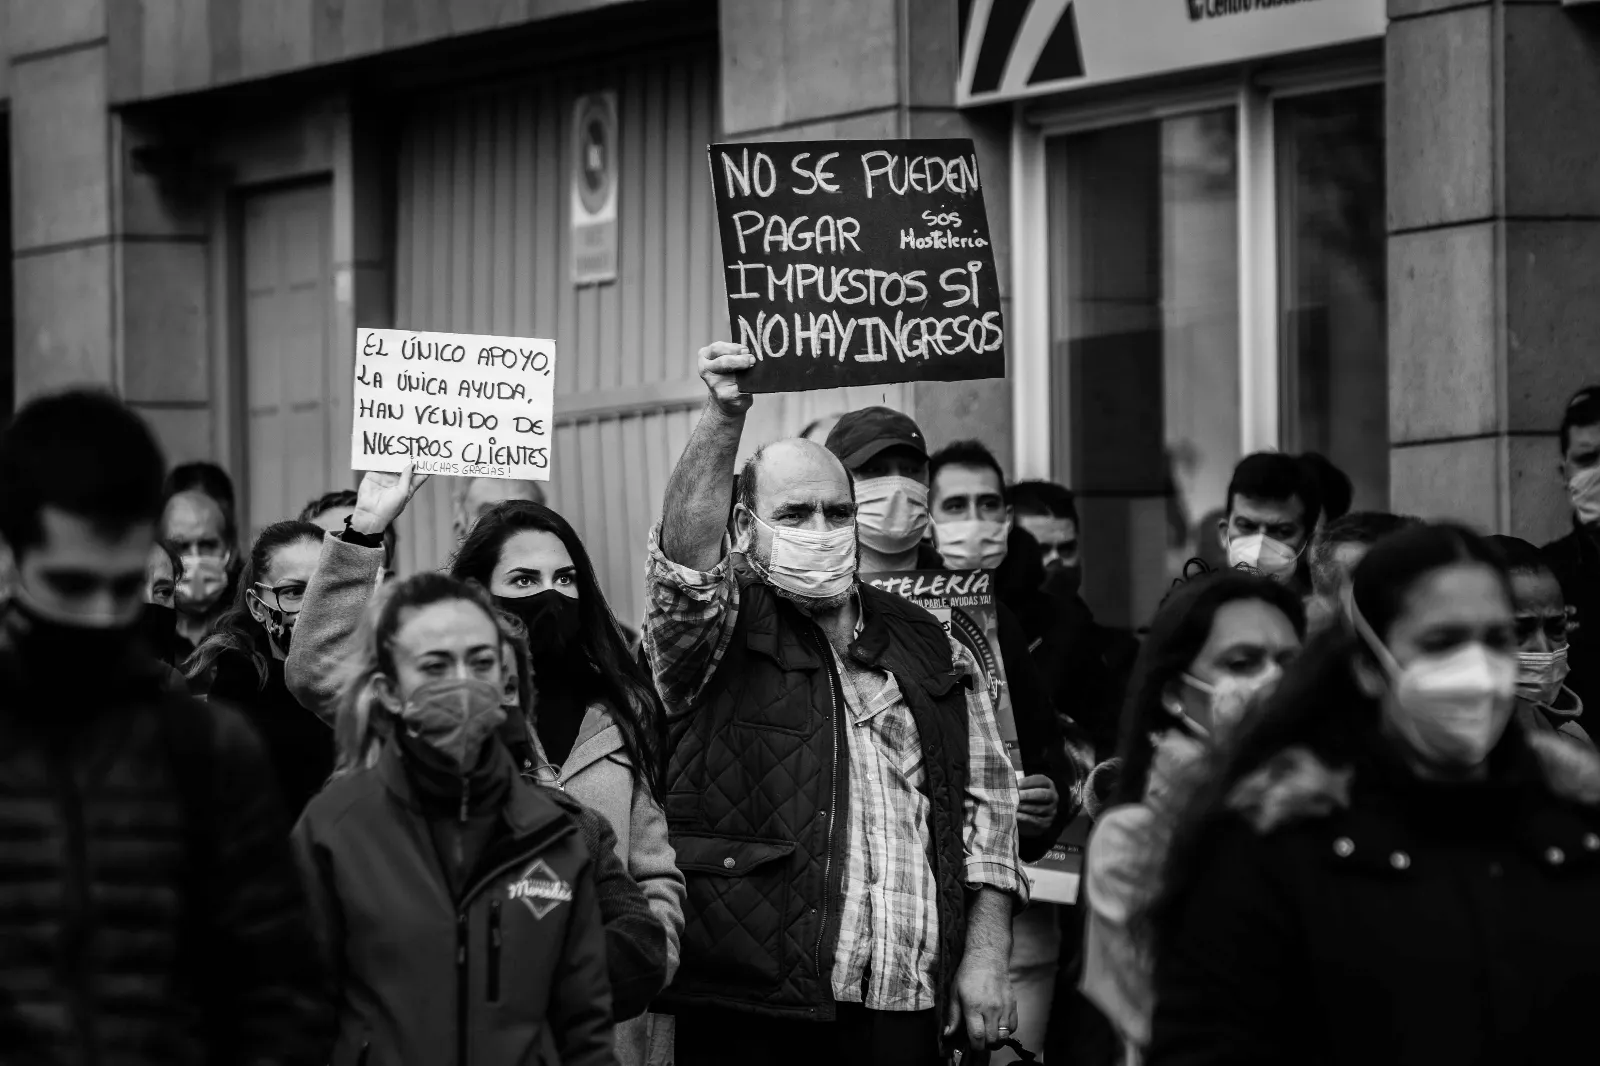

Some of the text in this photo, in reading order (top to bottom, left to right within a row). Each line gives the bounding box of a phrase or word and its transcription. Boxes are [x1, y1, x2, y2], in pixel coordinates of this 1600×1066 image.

[721, 147, 979, 199] NO SE PUEDEN
[732, 210, 862, 254] PAGAR
[727, 260, 929, 306] IMPUESTOS
[363, 333, 551, 377] EL ÚNICO APOYO,
[738, 309, 1004, 362] NO HAY INGRESOS
[357, 365, 383, 389] LA
[458, 379, 533, 404] AYUDA,
[359, 399, 404, 420] HAN
[513, 416, 545, 435] DE
[363, 431, 453, 459] NUESTROS
[950, 596, 979, 607] AYUDAS
[980, 595, 992, 605] YA!
